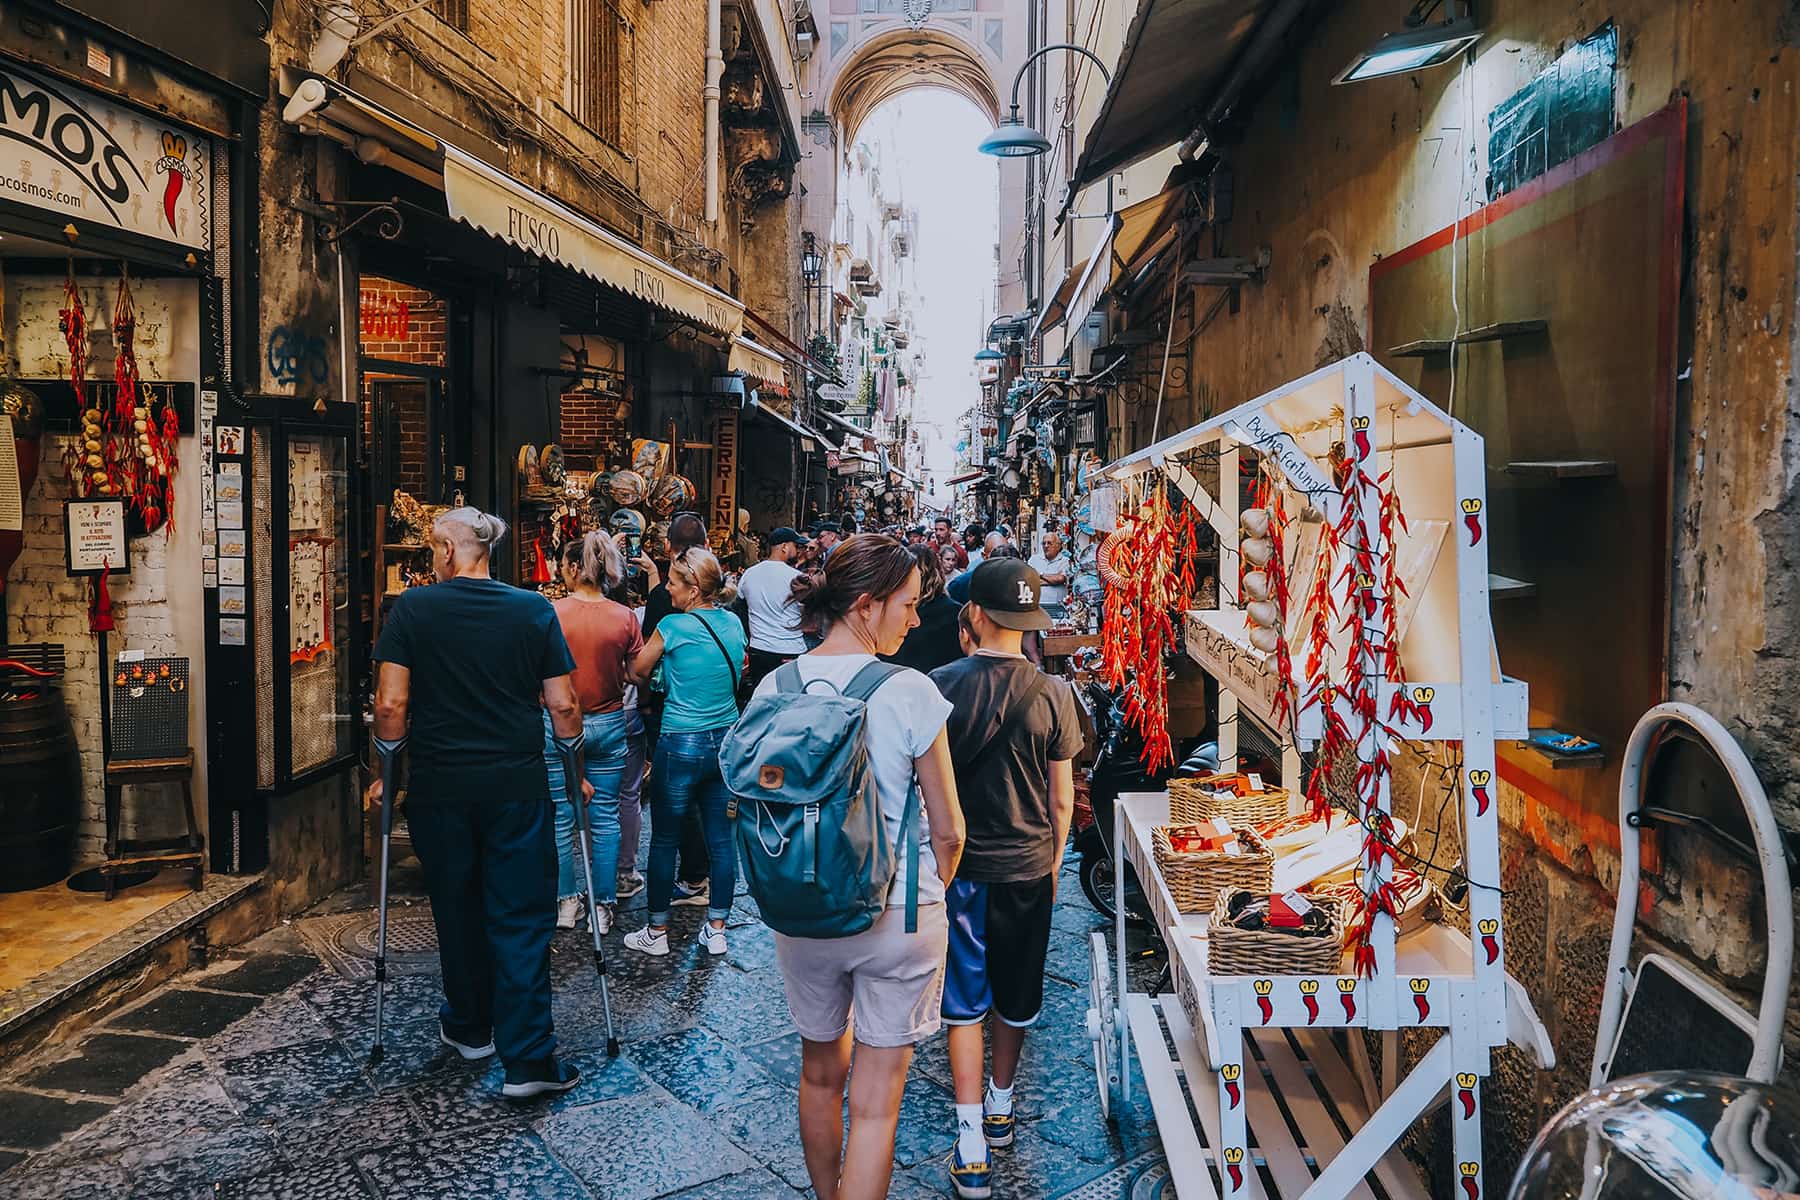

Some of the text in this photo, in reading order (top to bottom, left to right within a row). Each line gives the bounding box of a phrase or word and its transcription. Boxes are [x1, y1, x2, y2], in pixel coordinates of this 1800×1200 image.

[156, 156, 191, 181] COSMOS
[507, 206, 560, 258] FUSCO
[633, 268, 665, 302] FUSCO
[706, 303, 728, 325] FUSCO
[715, 418, 734, 531] FERRIGN
[1017, 580, 1034, 604] LA
